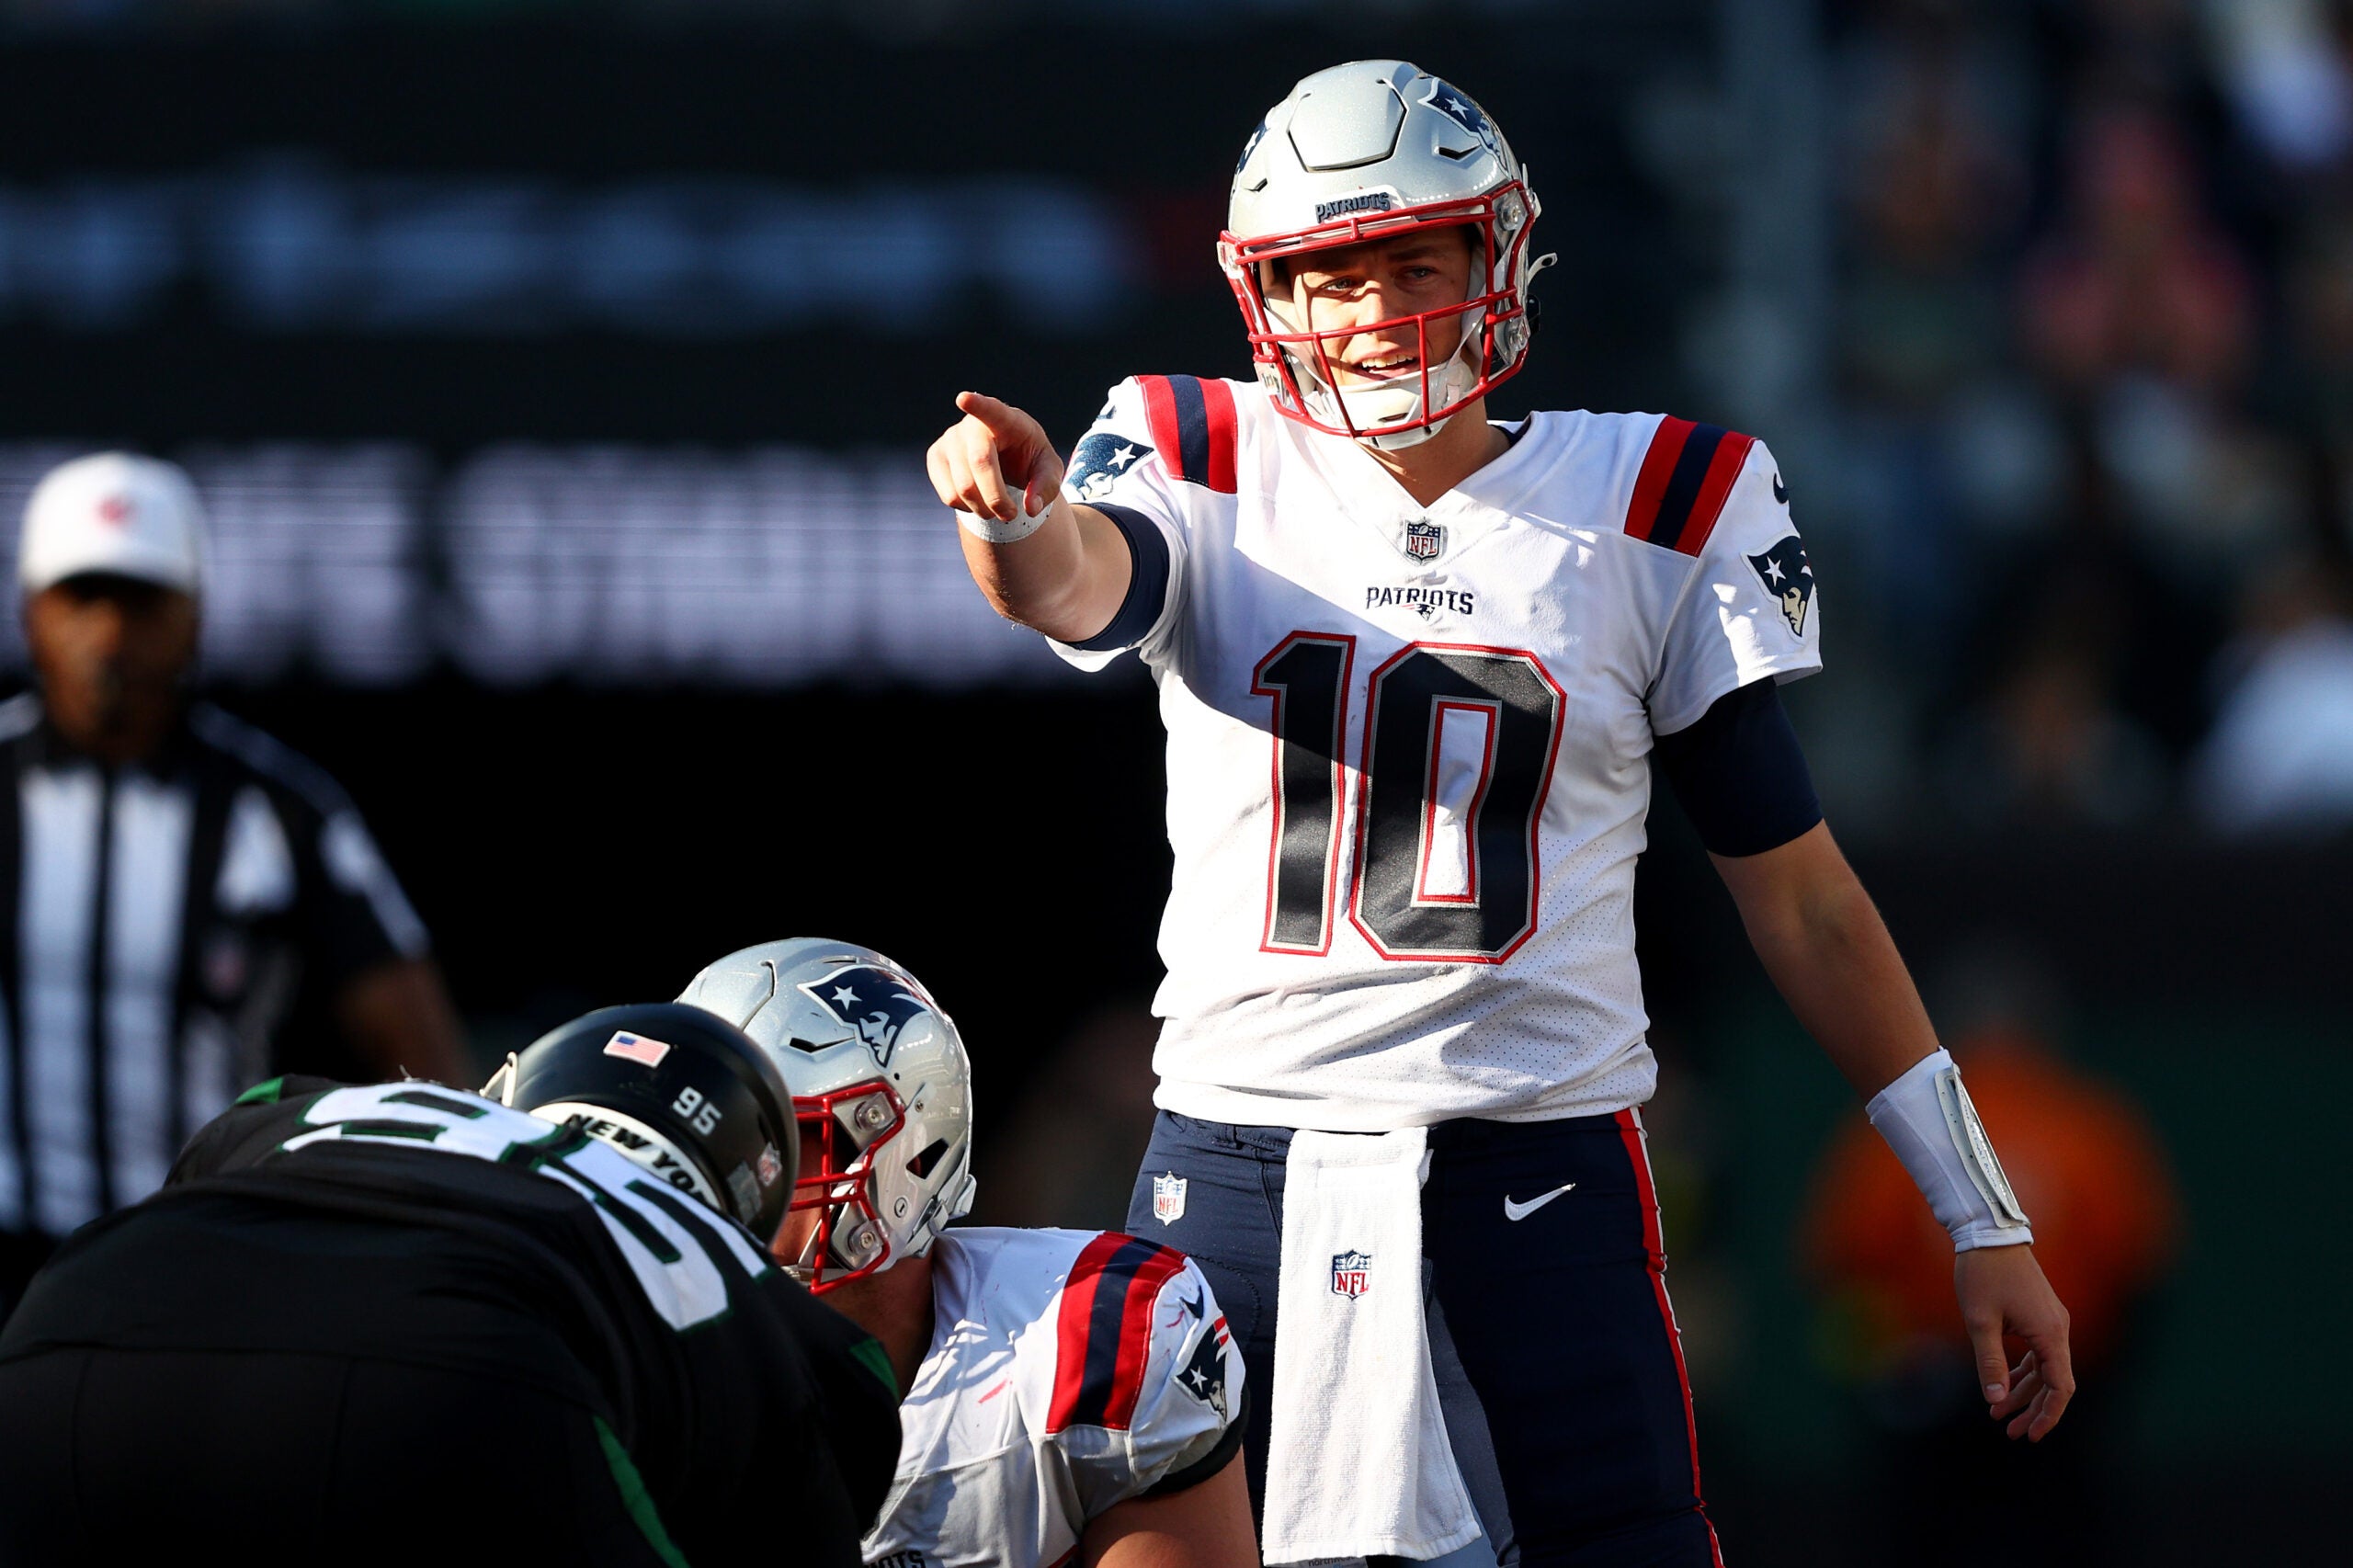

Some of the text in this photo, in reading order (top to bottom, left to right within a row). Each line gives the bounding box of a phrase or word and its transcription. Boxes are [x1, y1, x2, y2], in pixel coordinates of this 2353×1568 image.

[1315, 192, 1390, 223] PATRIOTS
[1409, 536, 1437, 556] NFL
[1366, 586, 1474, 615] PATRIOTS
[1250, 630, 1567, 965] 10
[672, 1086, 722, 1136] 95
[563, 1113, 652, 1150] NEW
[1158, 1196, 1178, 1214] NFL
[1336, 1270, 1370, 1295] NFL
